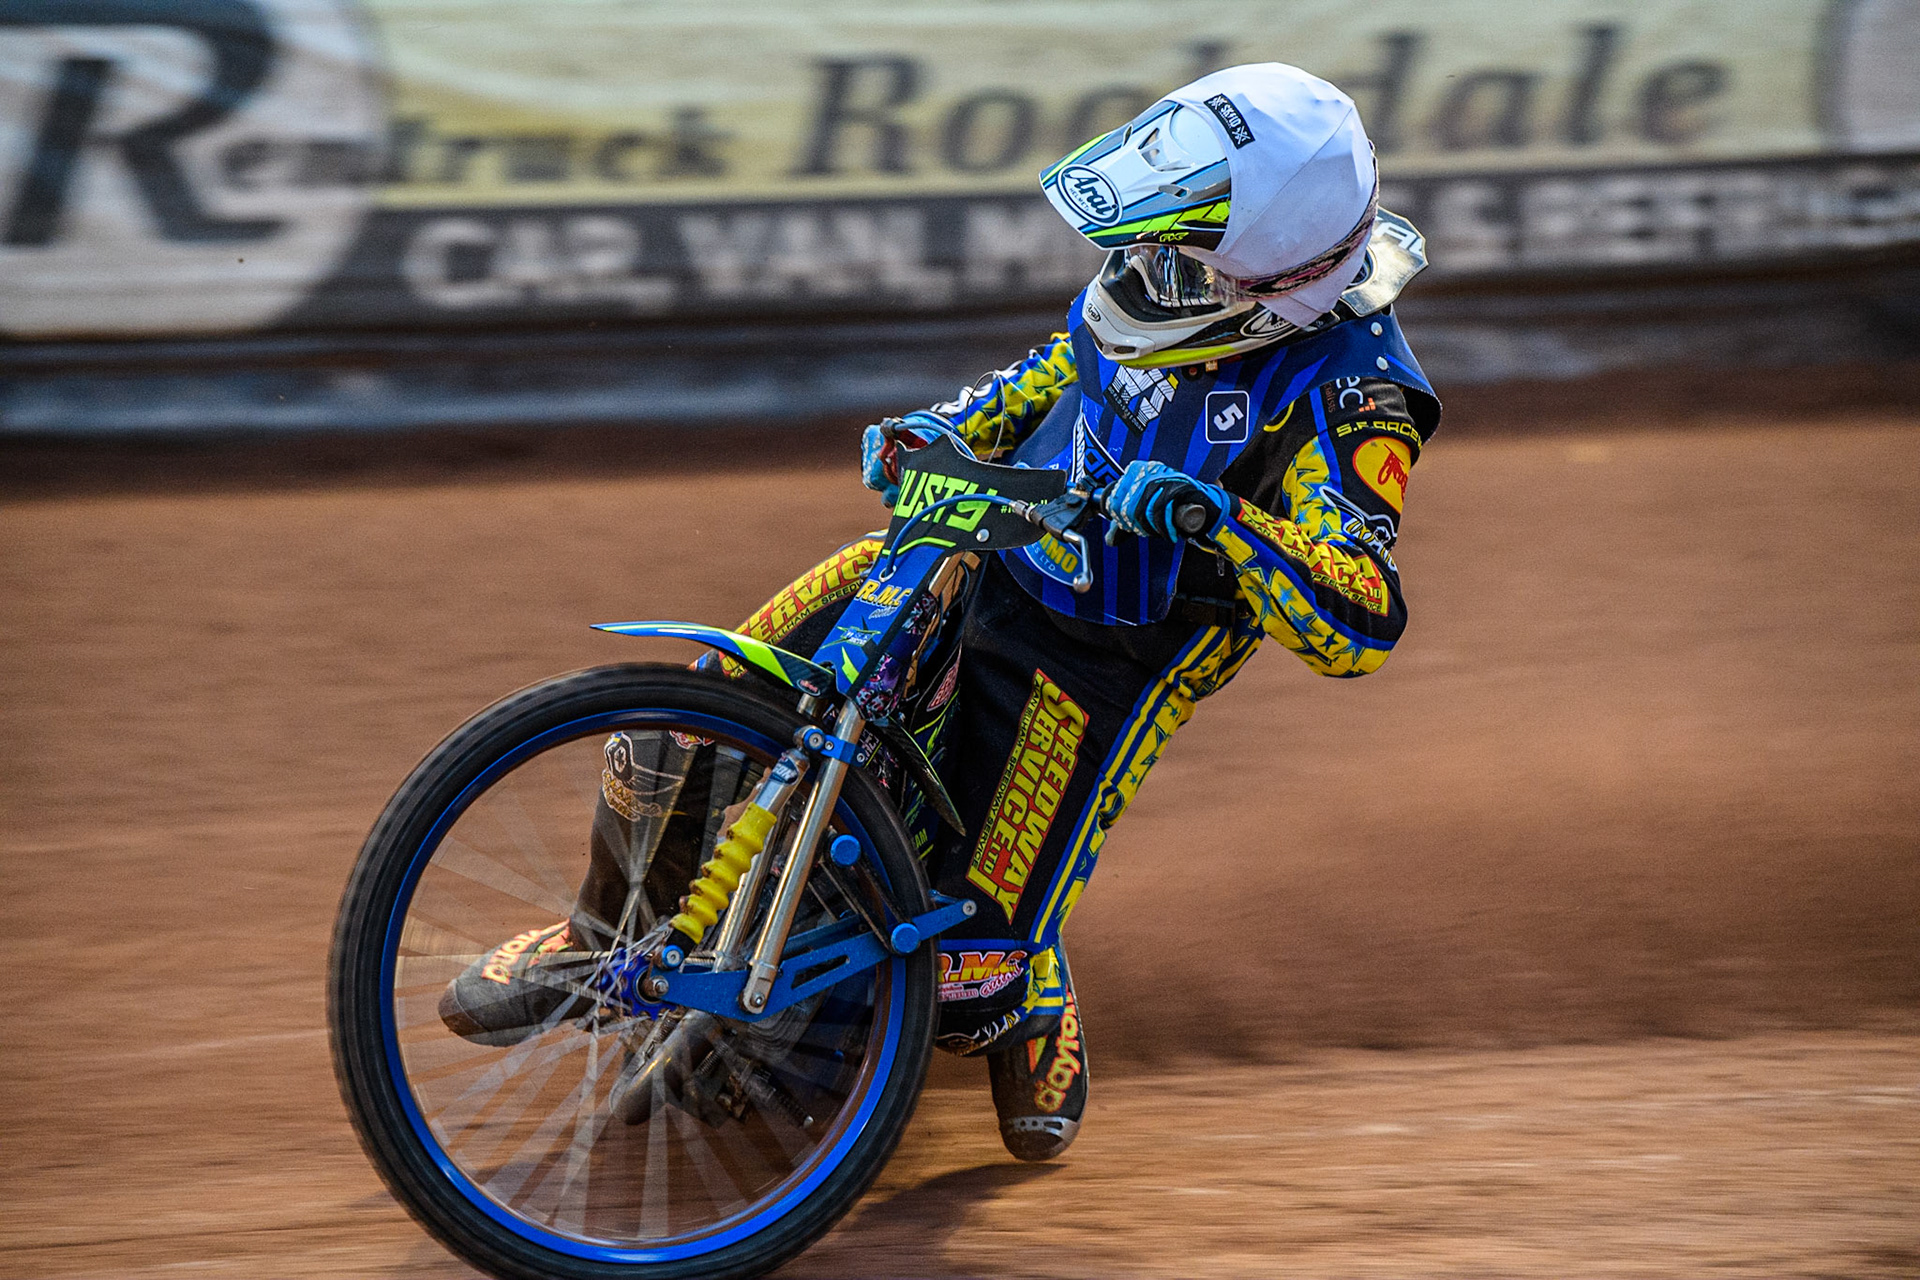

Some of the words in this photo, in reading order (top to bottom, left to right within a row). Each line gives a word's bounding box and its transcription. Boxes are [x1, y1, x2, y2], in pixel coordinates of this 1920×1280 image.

[1064, 173, 1118, 216] Arai
[1069, 187, 1090, 212] HELMET
[1213, 402, 1244, 432] 5
[1323, 382, 1336, 413] cialists
[892, 469, 999, 533] USTY
[1039, 532, 1078, 574] AMO
[1040, 555, 1056, 572] LTD
[990, 756, 1017, 814] SPEEDWAY
[996, 682, 1086, 921] SPEEDWAY
[911, 827, 928, 849] AM
[972, 816, 994, 869] SERVICE
[983, 842, 1001, 876] LTD
[1034, 983, 1081, 1113] dayton
